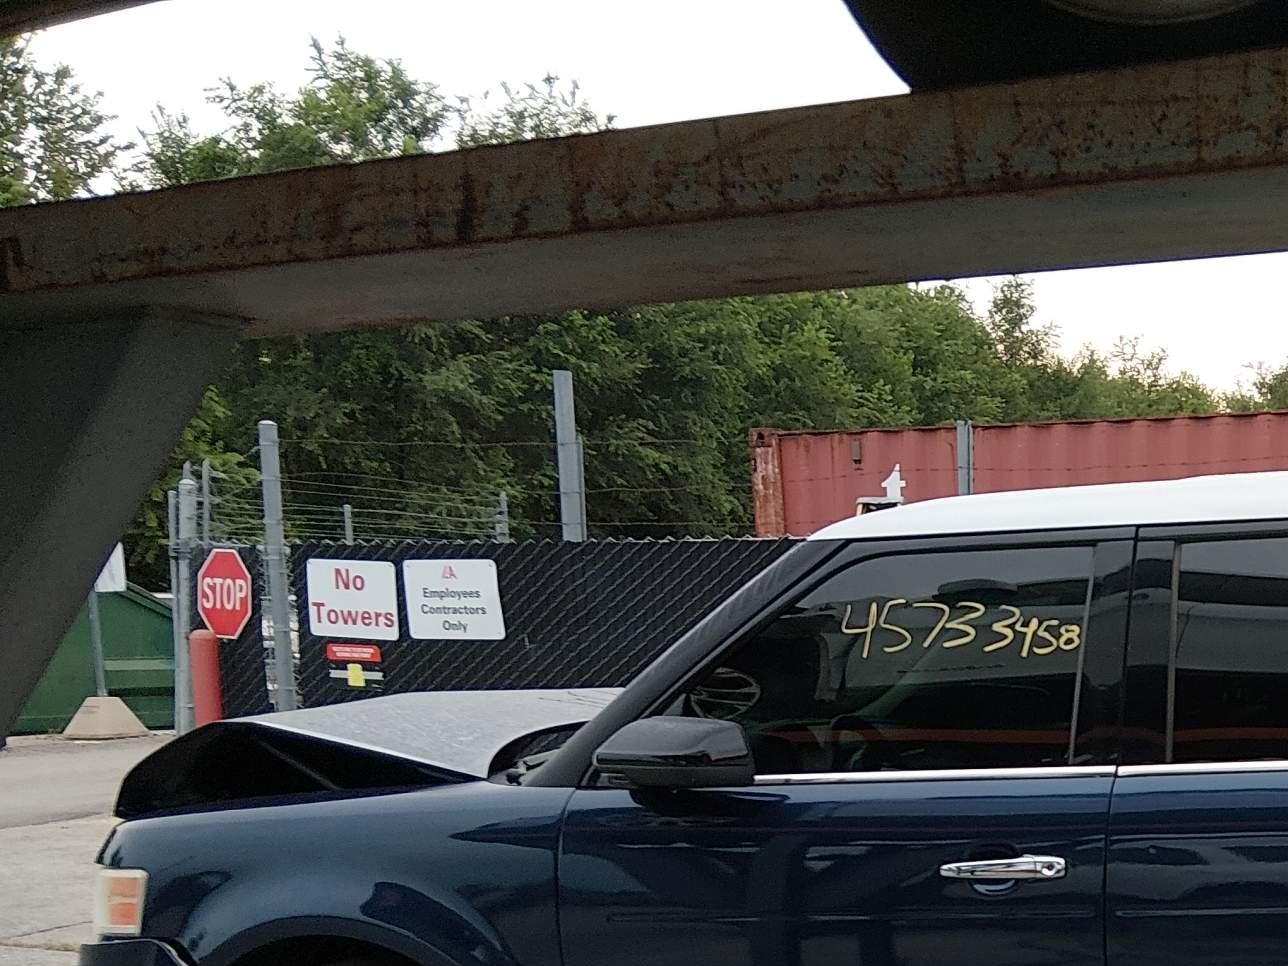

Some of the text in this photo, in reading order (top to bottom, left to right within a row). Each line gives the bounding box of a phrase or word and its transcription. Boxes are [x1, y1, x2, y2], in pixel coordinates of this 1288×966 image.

[334, 567, 365, 591] No
[202, 577, 247, 610] STOP
[422, 587, 481, 600] Employees
[311, 602, 395, 628] Towers
[421, 603, 488, 615] Contractors
[442, 620, 468, 633] Only
